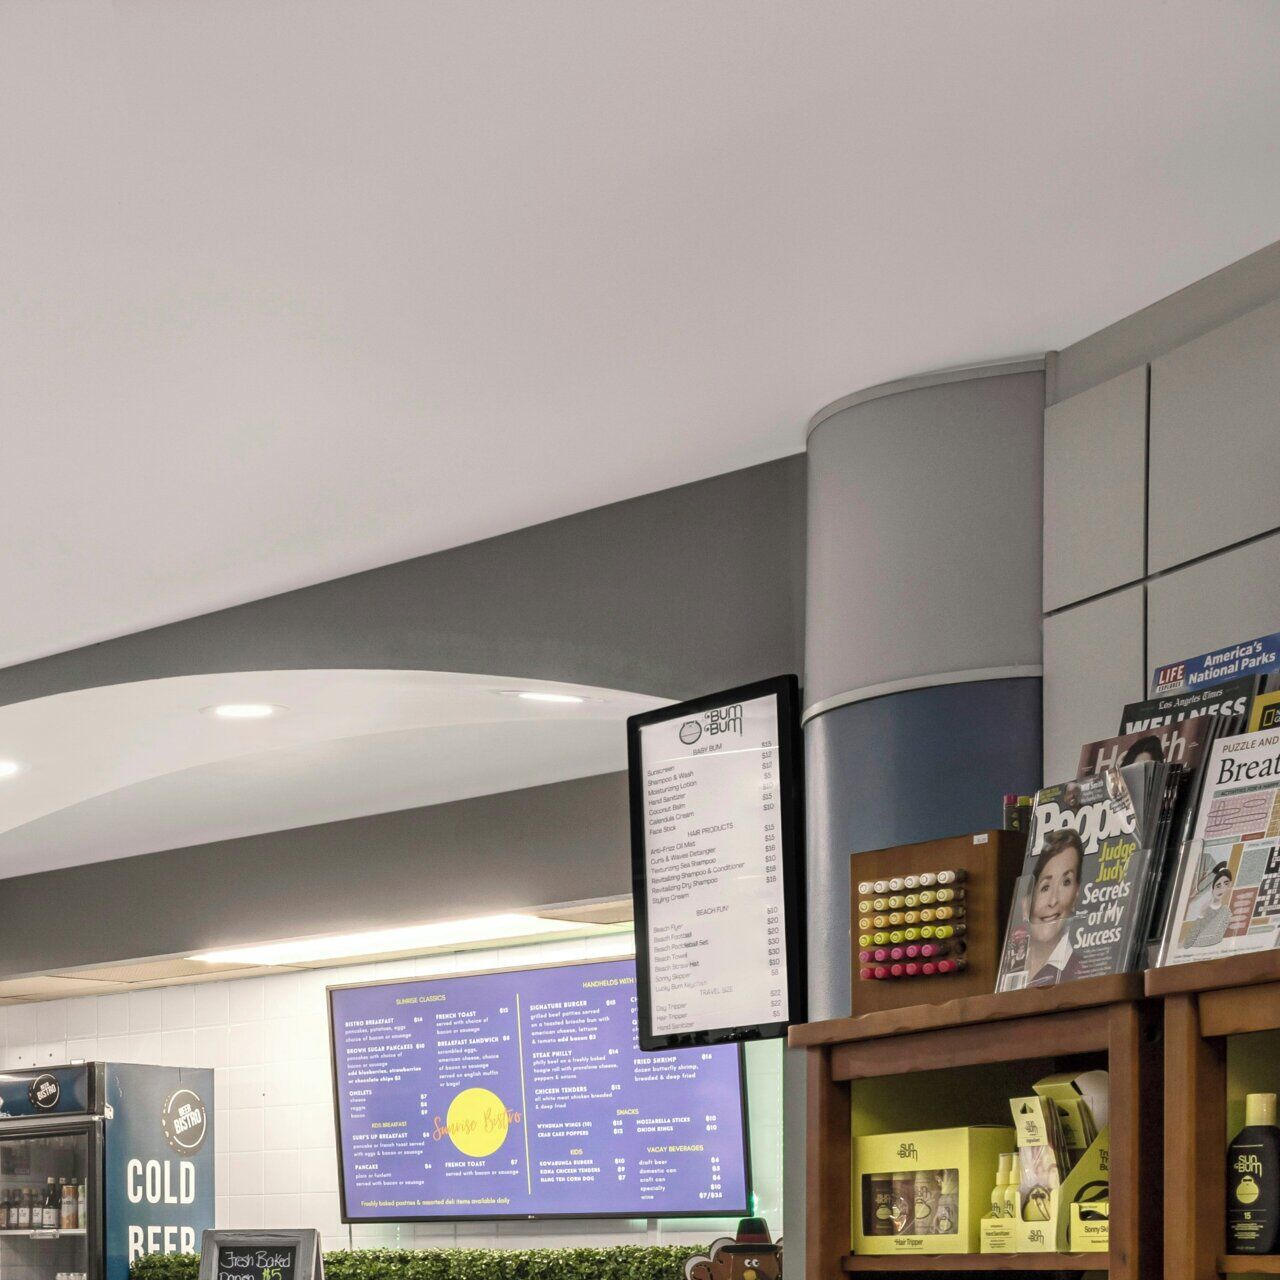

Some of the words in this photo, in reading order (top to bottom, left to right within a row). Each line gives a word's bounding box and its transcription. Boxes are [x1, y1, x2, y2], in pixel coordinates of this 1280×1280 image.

[1203, 642, 1263, 668] America's
[1158, 665, 1185, 687] LIFE
[1187, 661, 1240, 686] National
[1240, 652, 1277, 676] Parks
[1158, 700, 1173, 711] Los
[1173, 694, 1201, 709] Angeles
[1202, 689, 1224, 702] Times
[1094, 730, 1187, 775] Heth
[1222, 740, 1256, 754] PUZZLE
[1258, 736, 1280, 749] AND
[1031, 800, 1137, 857] People
[1099, 838, 1137, 863] Judge
[1082, 880, 1132, 905] Secrets
[1088, 903, 1104, 925] of
[1103, 901, 1125, 924] My
[1073, 927, 1122, 950] Success
[36, 1084, 58, 1101] BISTRO
[174, 1108, 203, 1135] BISTRO
[127, 1158, 196, 1205] COLD
[1243, 1211, 1252, 1220] 15
[128, 1225, 196, 1270] BEER
[906, 1237, 924, 1248] Tripper
[220, 1251, 255, 1268] Fresh
[255, 1250, 291, 1268] Baked
